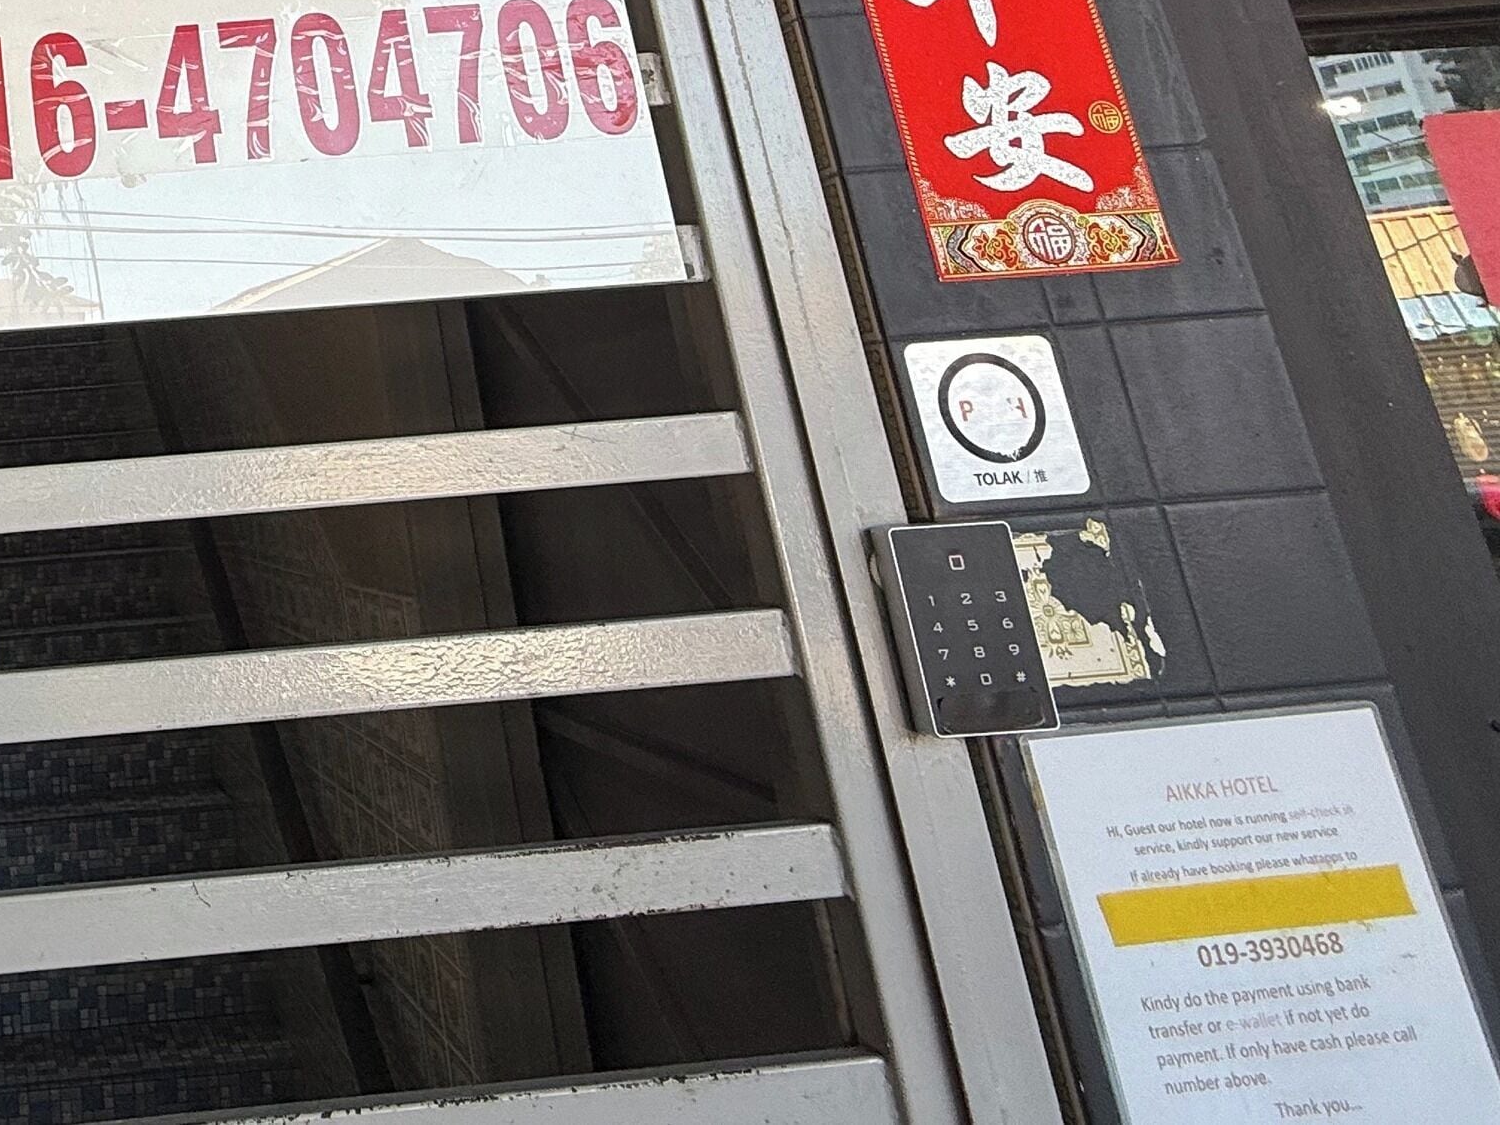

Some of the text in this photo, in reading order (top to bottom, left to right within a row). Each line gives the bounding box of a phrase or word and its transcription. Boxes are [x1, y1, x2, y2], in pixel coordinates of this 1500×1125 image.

[973, 470, 1023, 486] TOLAK
[960, 593, 972, 605] 2
[995, 591, 1007, 602] 3
[933, 618, 1013, 633] 4 5 6
[938, 644, 1019, 660] 7 8 9
[1165, 775, 1279, 802] AIKKA HOTEL
[1124, 821, 1156, 836] Guest
[1158, 820, 1176, 833] our
[1178, 816, 1207, 831] hotel
[1209, 818, 1232, 829] now
[1234, 814, 1243, 826] is
[1245, 810, 1288, 825] running
[1134, 826, 1338, 856] service, kindly support our new service
[1141, 867, 1180, 883] already
[1182, 864, 1208, 877] have
[1210, 859, 1253, 875] booking
[1254, 855, 1291, 872] please
[1345, 850, 1358, 861] to
[1197, 931, 1344, 967] 019-3930468
[1140, 974, 1372, 1013] Kindy do the payment using bank
[1148, 1019, 1203, 1039] transfer
[1207, 1020, 1222, 1033] or
[1226, 1013, 1284, 1032] e-wallet
[1299, 1007, 1324, 1024] not
[1325, 1005, 1349, 1026] yet
[1351, 1002, 1370, 1018] do
[1156, 1025, 1418, 1070] payment. If only have cash please call
[1164, 1070, 1272, 1095] number above.
[1274, 1098, 1322, 1118] Thank
